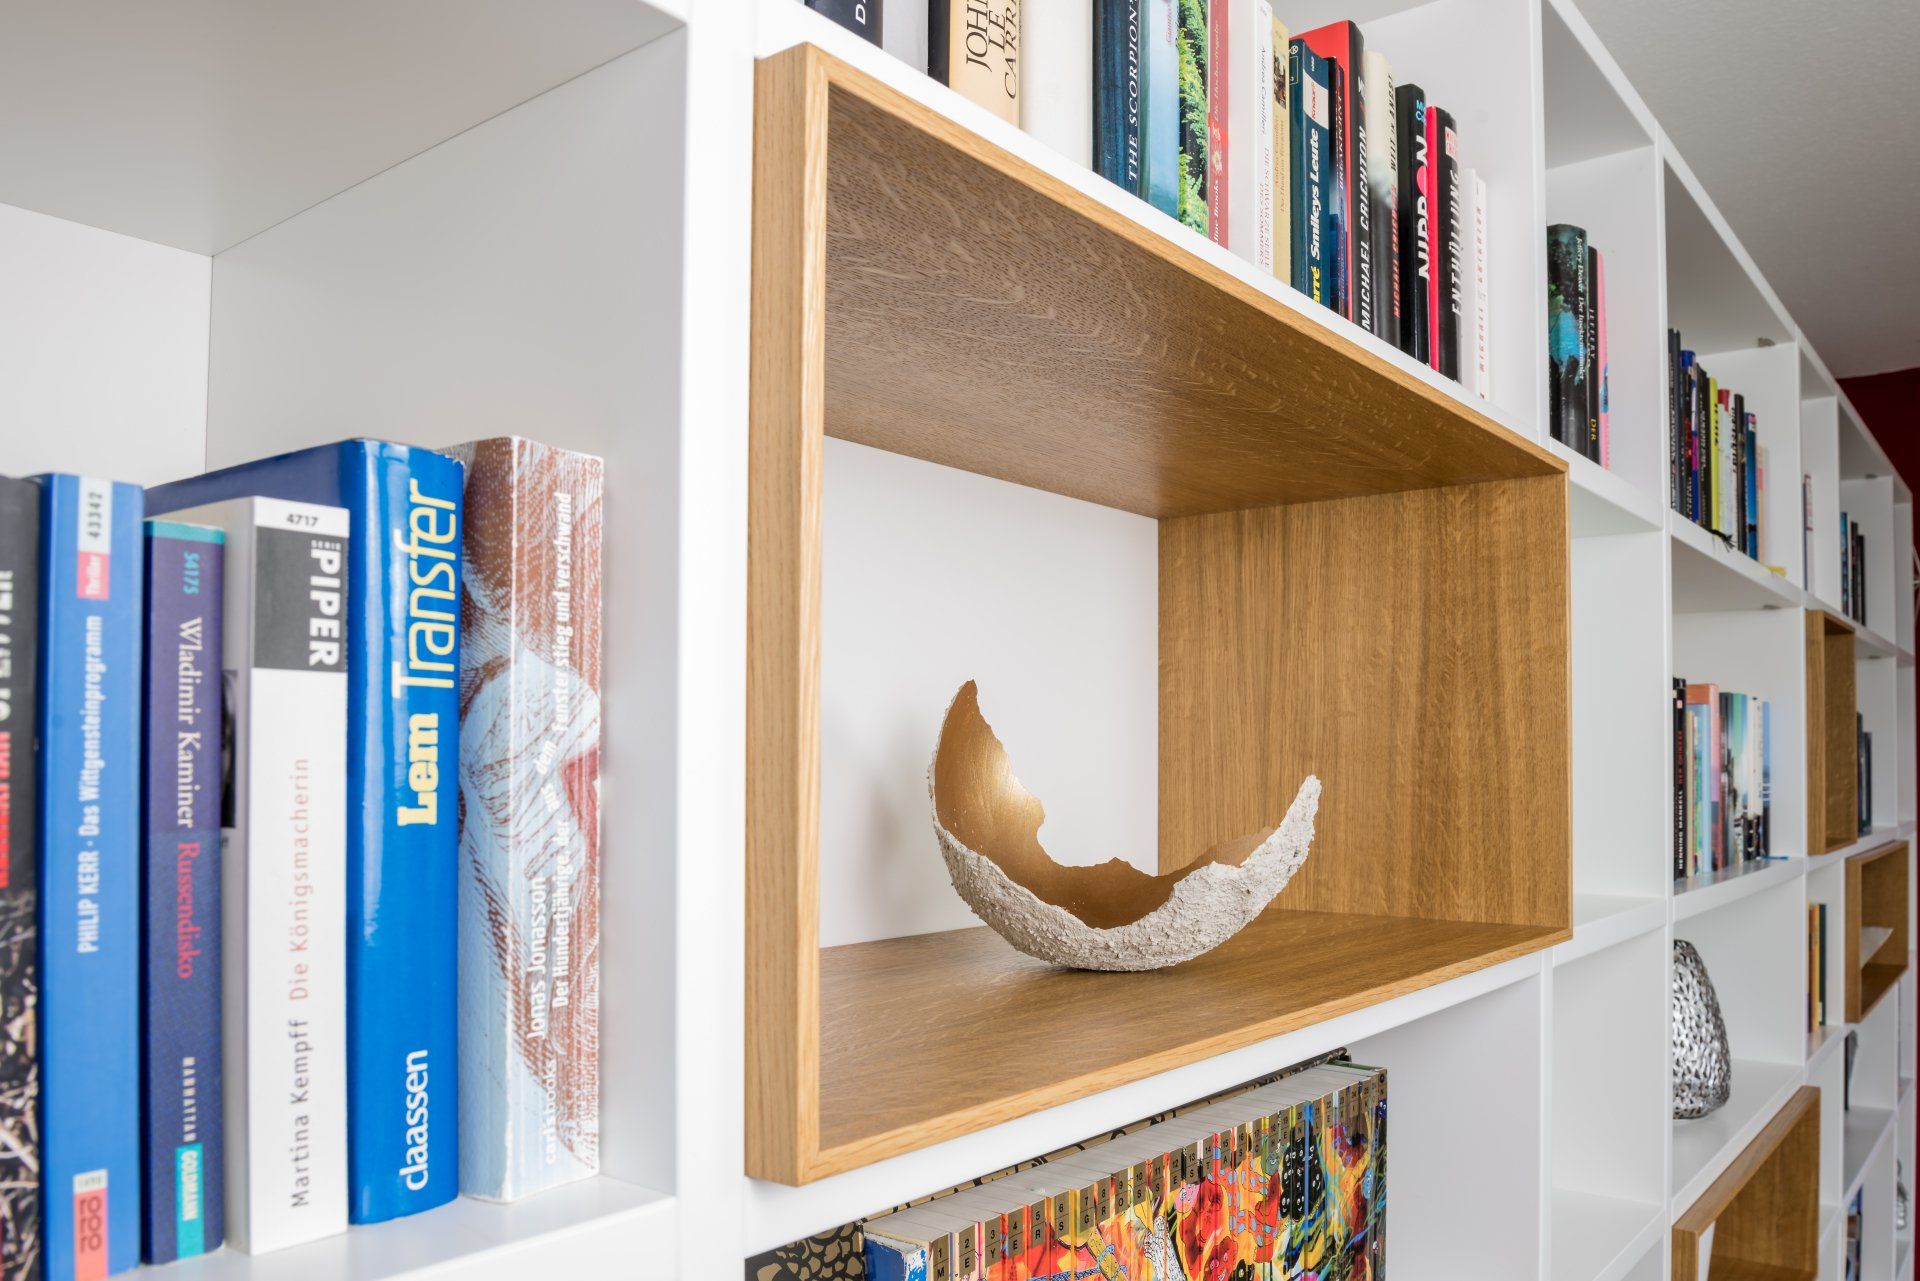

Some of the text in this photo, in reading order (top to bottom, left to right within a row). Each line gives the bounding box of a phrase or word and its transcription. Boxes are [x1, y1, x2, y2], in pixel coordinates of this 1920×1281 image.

[855, 0, 866, 25] D
[966, 0, 992, 72] JOH
[988, 10, 1005, 53] LE
[1004, 0, 1017, 99] CARR
[1128, 0, 1138, 181] THE SCORPION'
[1310, 128, 1320, 184] Leute
[1310, 185, 1322, 261] Smileys
[1358, 126, 1371, 331] MICHAEL CRICHTON
[87, 490, 104, 540] 43342
[286, 513, 319, 528] 4717
[552, 492, 572, 588] verschwand
[182, 551, 200, 595] 54175
[309, 548, 341, 666] PIPER
[551, 591, 571, 622] und
[391, 477, 457, 826] Lem Transfer
[551, 626, 574, 667] stieg
[177, 616, 203, 829] Wladimir Kaminer
[552, 670, 569, 732] Fenster
[77, 615, 107, 954] PHILIP KERR Das Wittgensteinprogramm
[553, 820, 571, 846] der
[176, 842, 202, 979] Russendisko
[288, 758, 313, 1208] Martina Kempff Die Königsmacherin
[527, 876, 547, 1040] Jonas Jonasson
[553, 984, 570, 1008] Der
[399, 1049, 429, 1191] claassen
[180, 1150, 200, 1221] GOLDMANN
